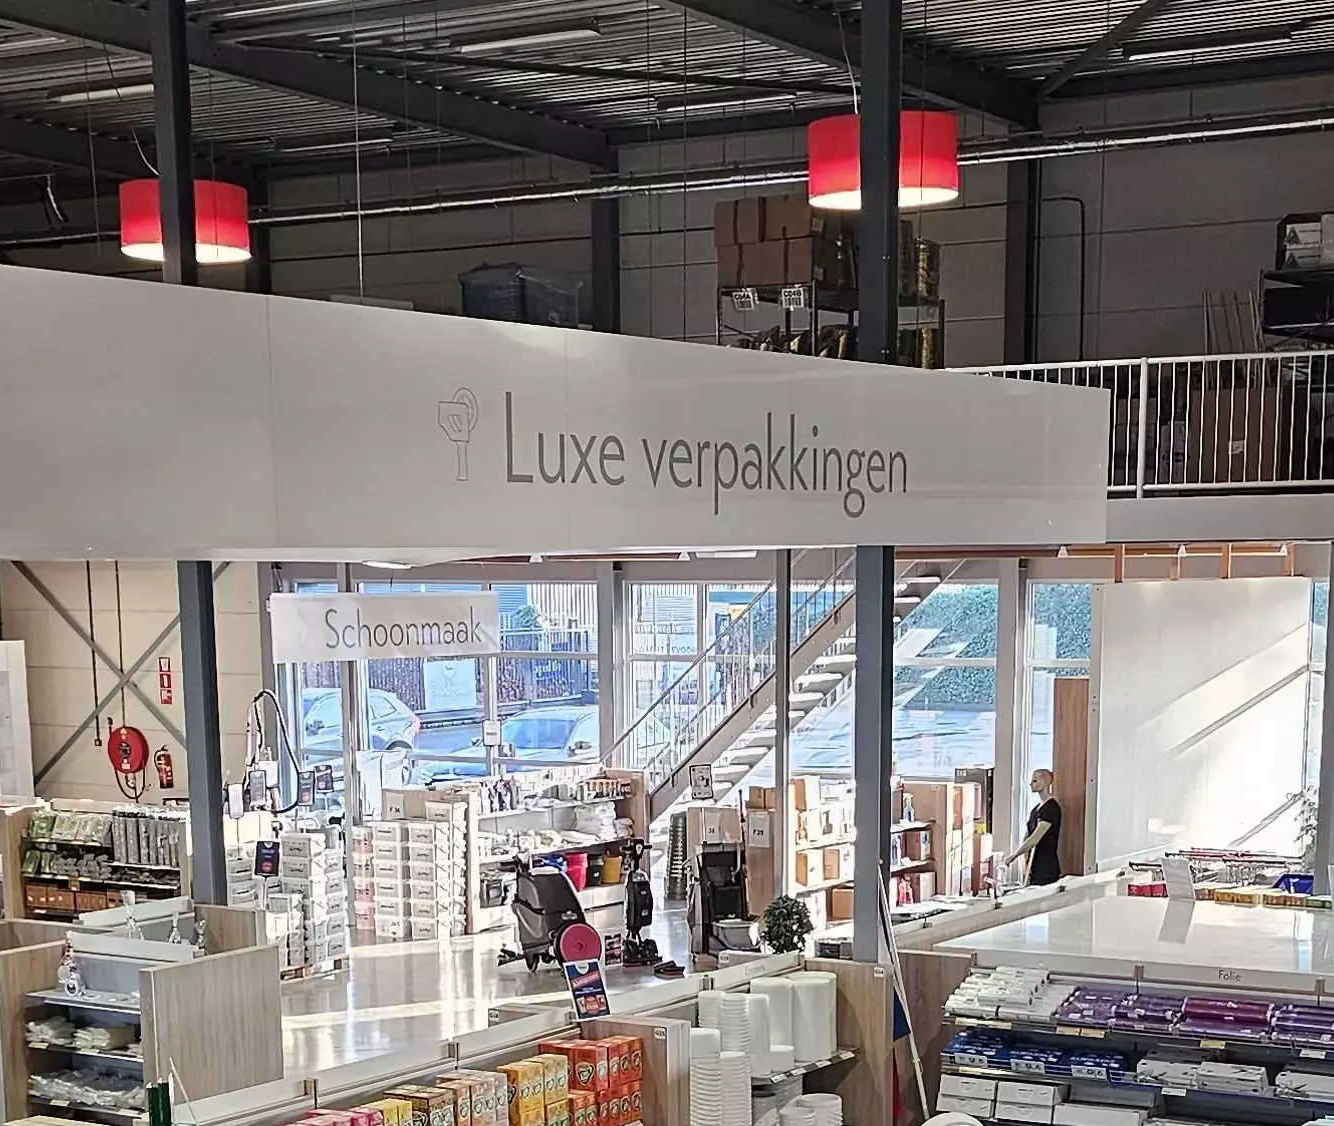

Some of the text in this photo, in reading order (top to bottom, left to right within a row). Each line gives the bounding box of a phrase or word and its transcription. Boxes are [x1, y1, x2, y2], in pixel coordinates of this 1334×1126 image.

[504, 390, 908, 519] Luxe verpakkingen
[324, 605, 482, 649] Schoonmaak
[1218, 969, 1242, 982] Folie
